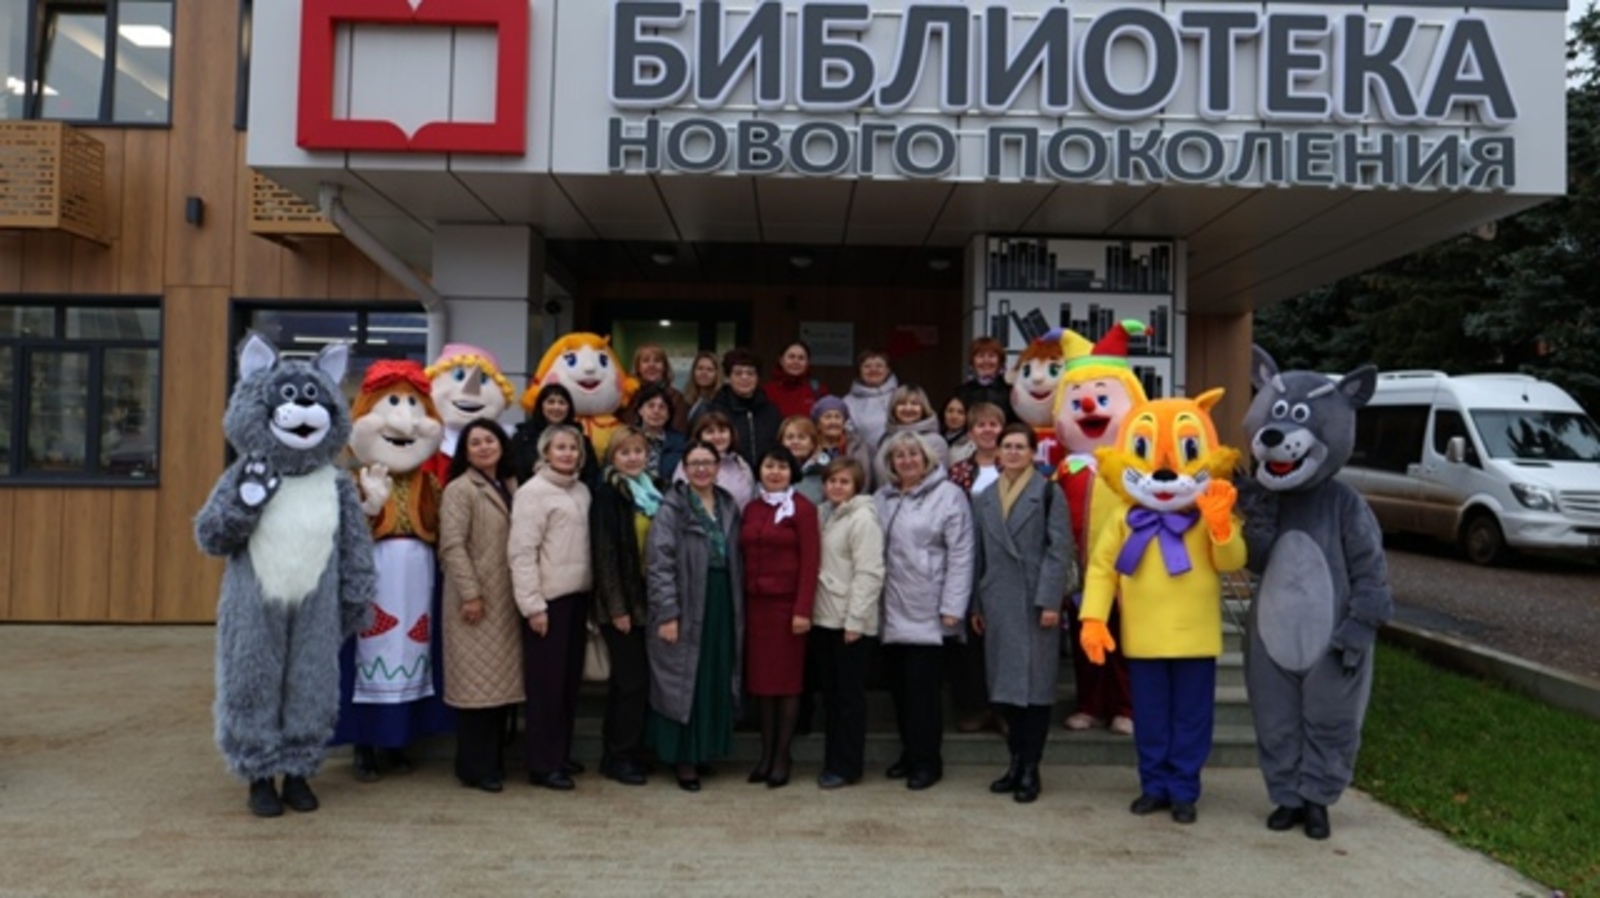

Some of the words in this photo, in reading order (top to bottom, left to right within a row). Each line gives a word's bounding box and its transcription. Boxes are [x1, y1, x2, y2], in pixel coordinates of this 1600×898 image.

[611, 0, 1518, 120] БИБЛИОТЕКА
[607, 117, 957, 176] НОВОГО
[986, 126, 1517, 188] ПОКОЛЕНИЯ
